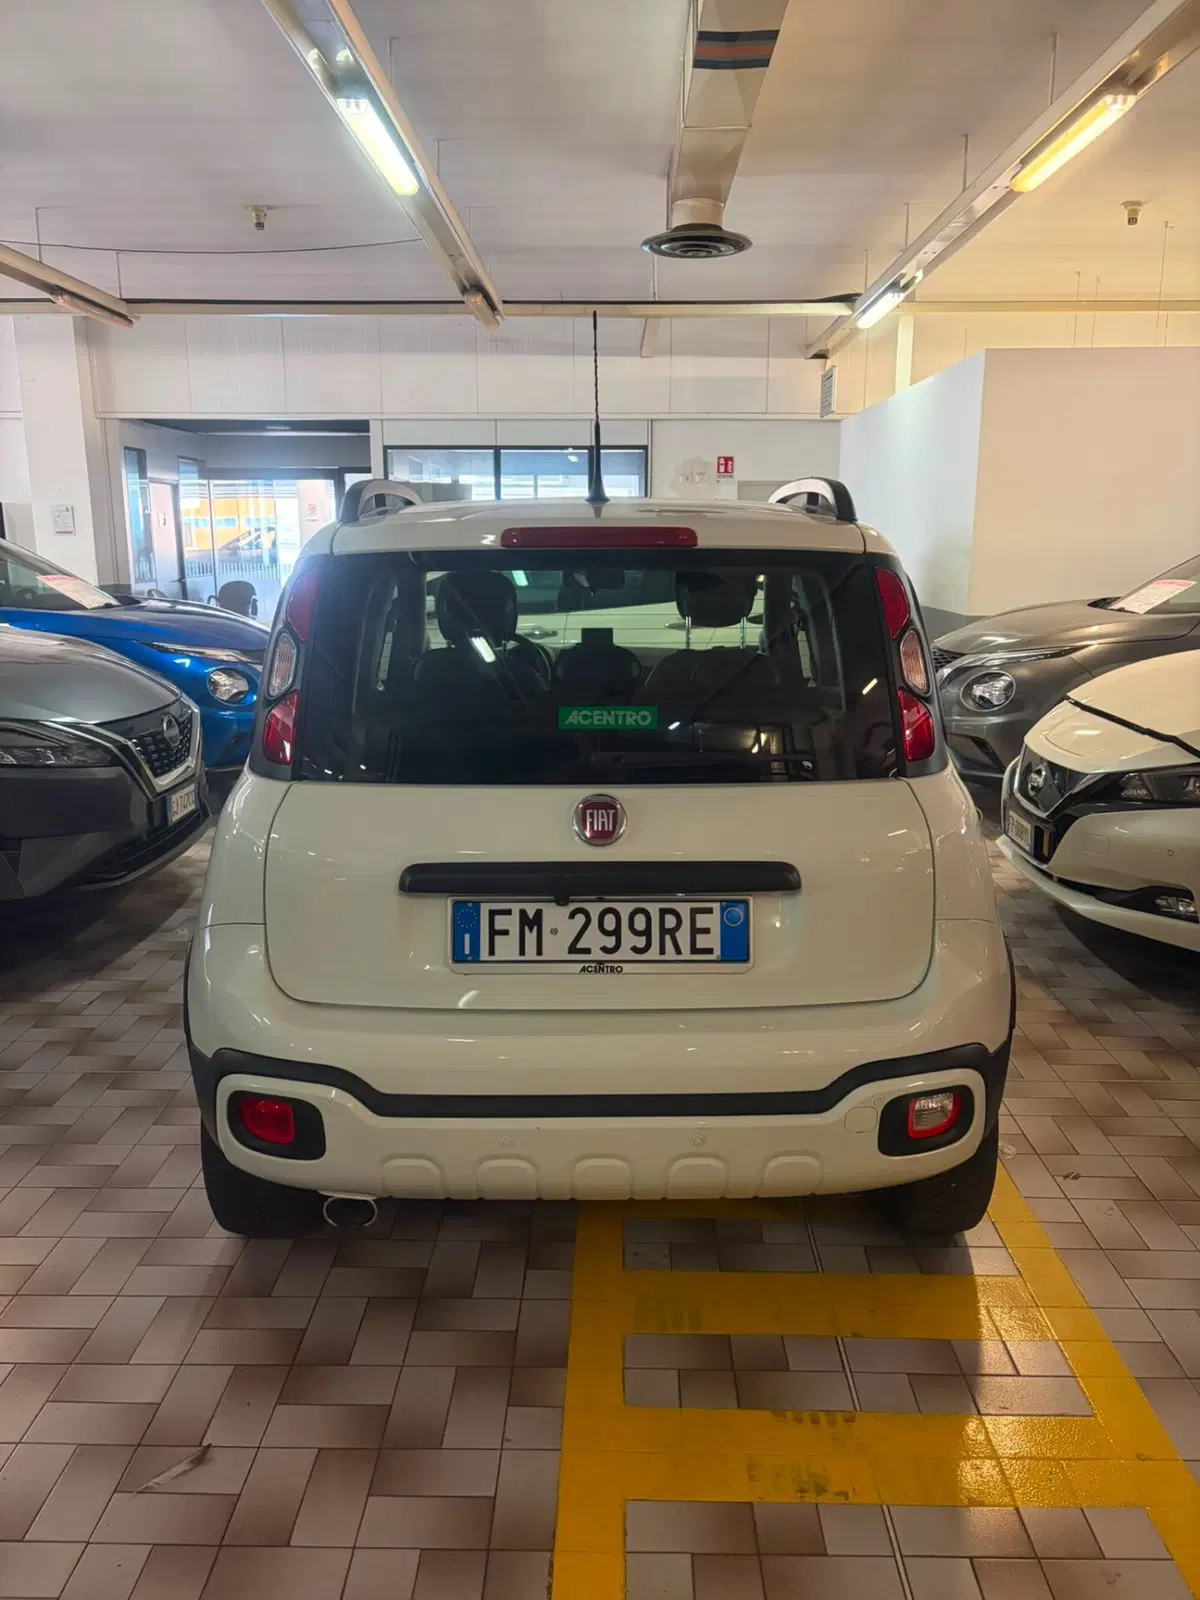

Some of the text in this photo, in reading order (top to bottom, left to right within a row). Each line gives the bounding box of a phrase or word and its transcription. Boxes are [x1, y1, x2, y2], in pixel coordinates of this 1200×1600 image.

[564, 709, 652, 726] ACENTRO
[586, 809, 616, 832] FIAT
[488, 907, 715, 956] FM 299RE
[579, 964, 624, 975] ACENTRO
